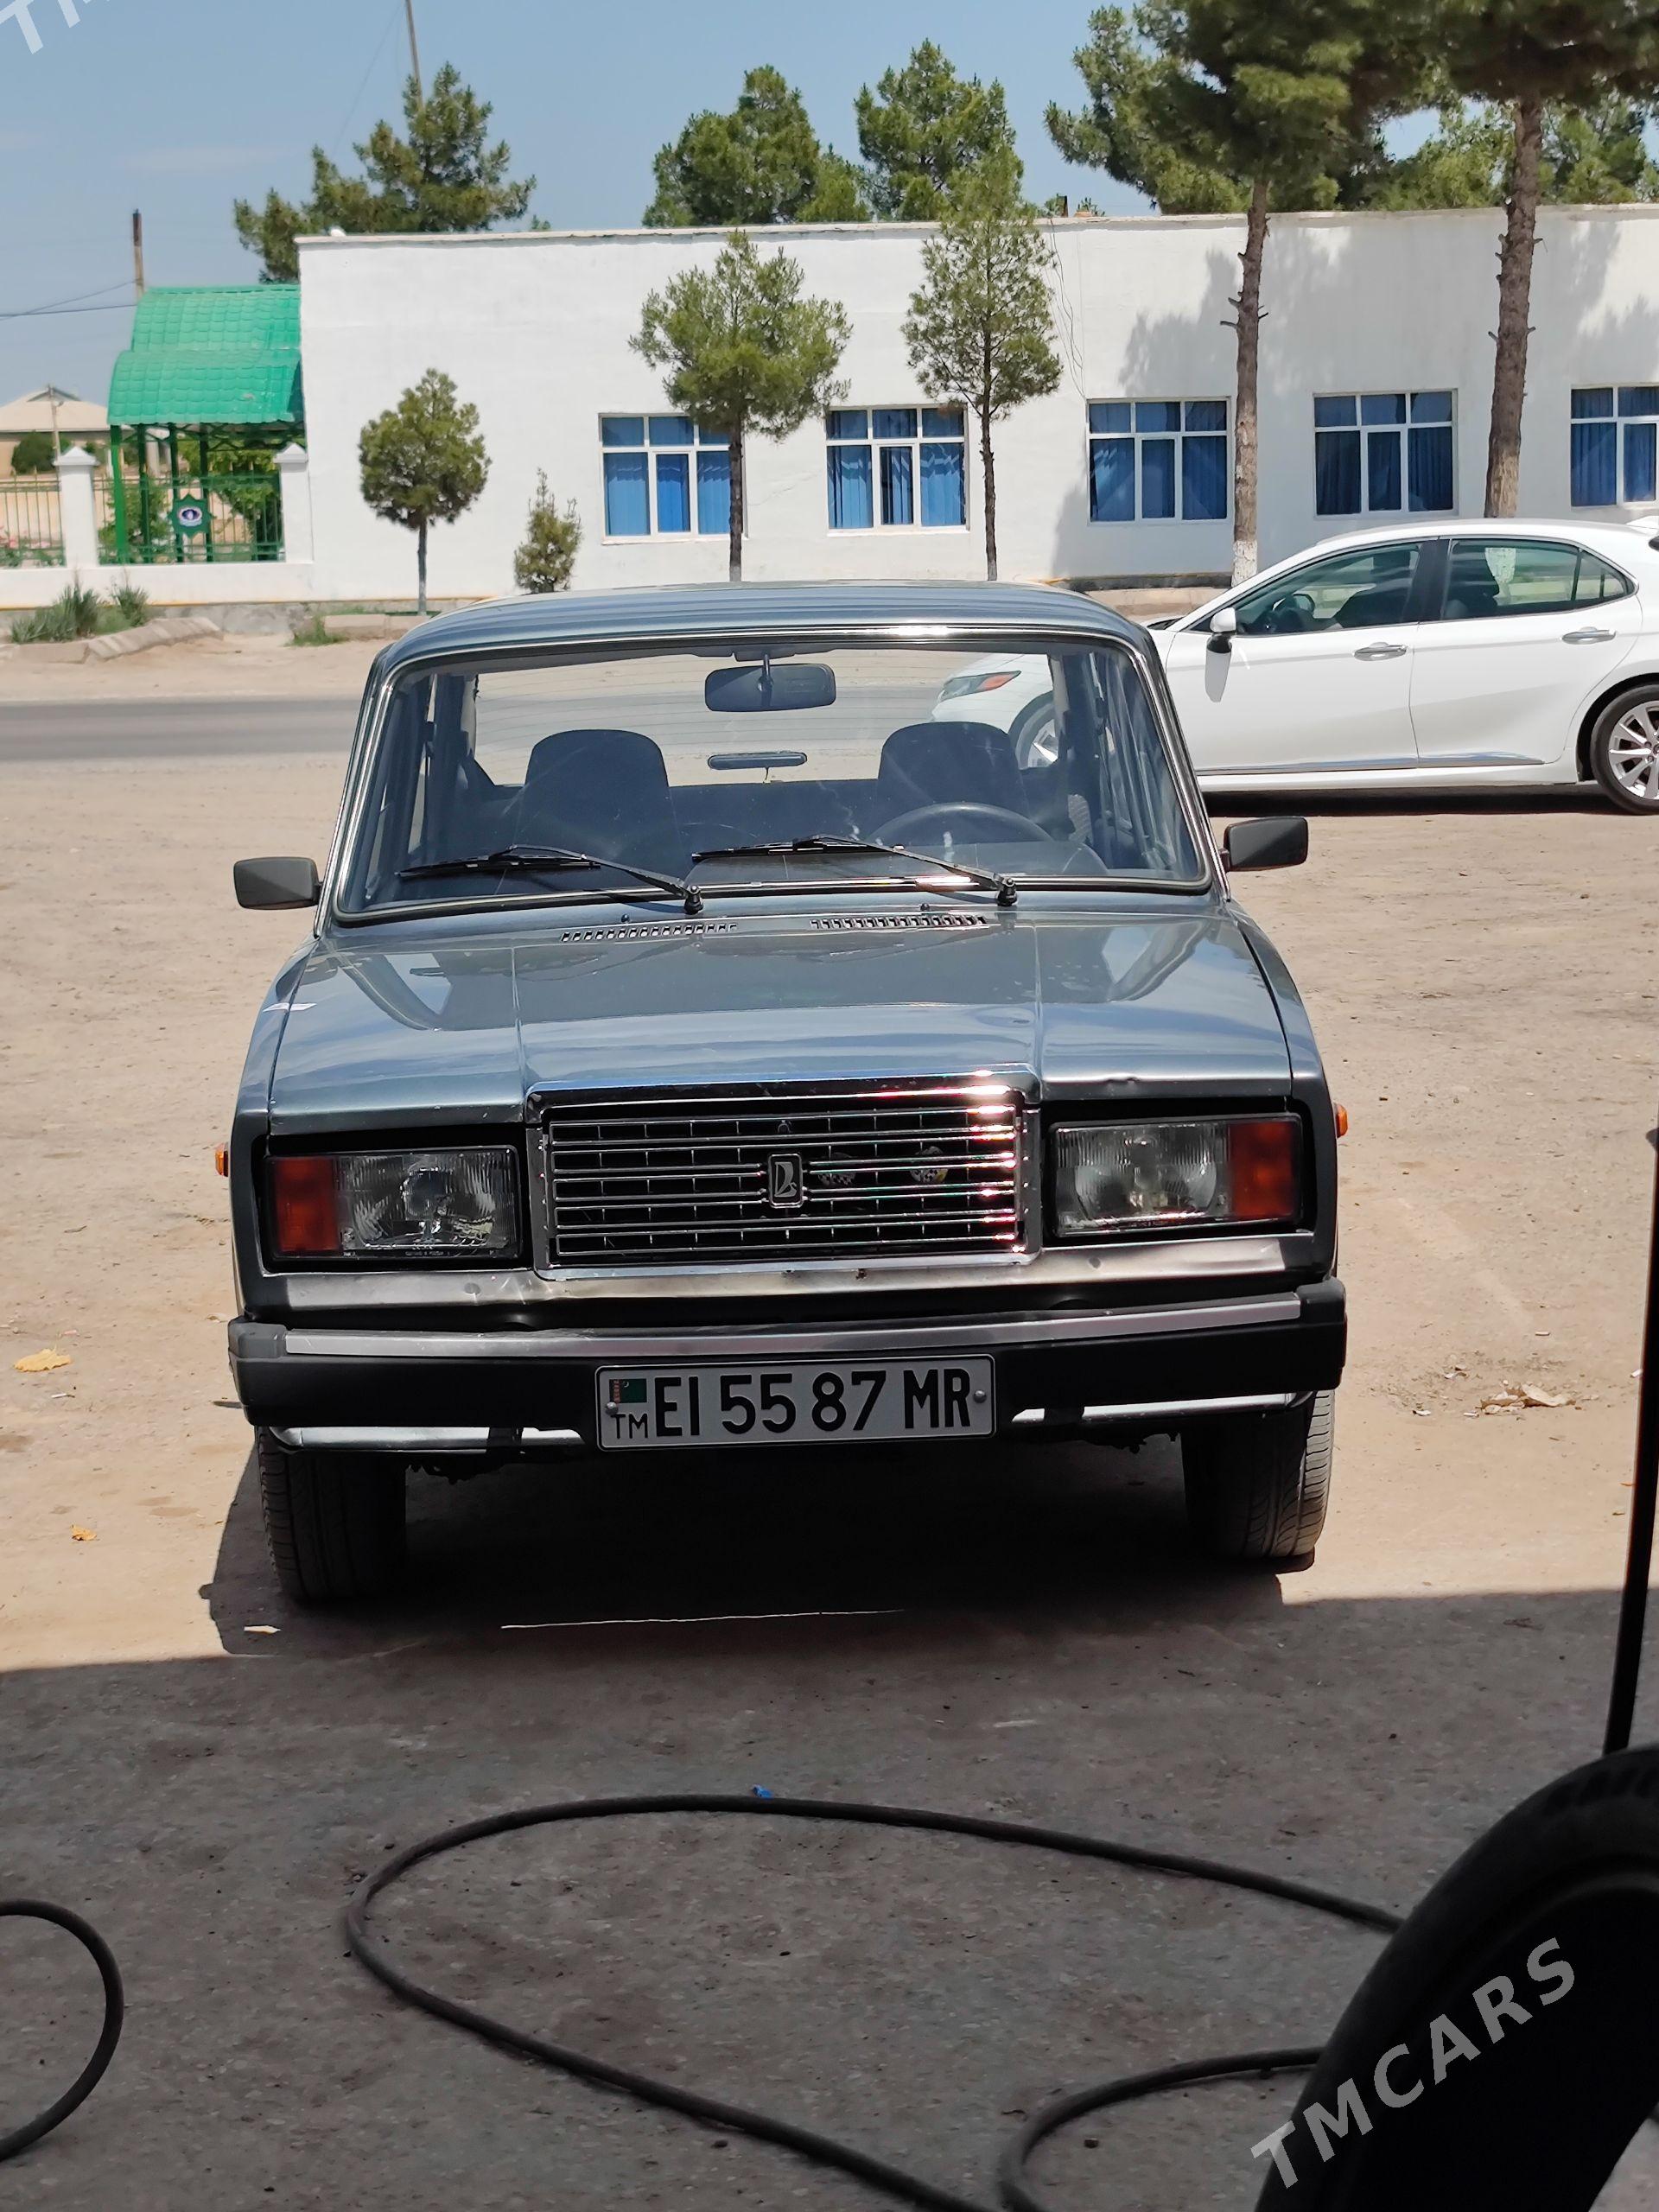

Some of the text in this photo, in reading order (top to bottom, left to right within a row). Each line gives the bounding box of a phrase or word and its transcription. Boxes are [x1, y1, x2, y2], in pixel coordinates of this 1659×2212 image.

[719, 1373, 796, 1434] 55
[810, 1370, 887, 1432] 87
[903, 1368, 971, 1428] MR
[612, 1414, 648, 1439] TM
